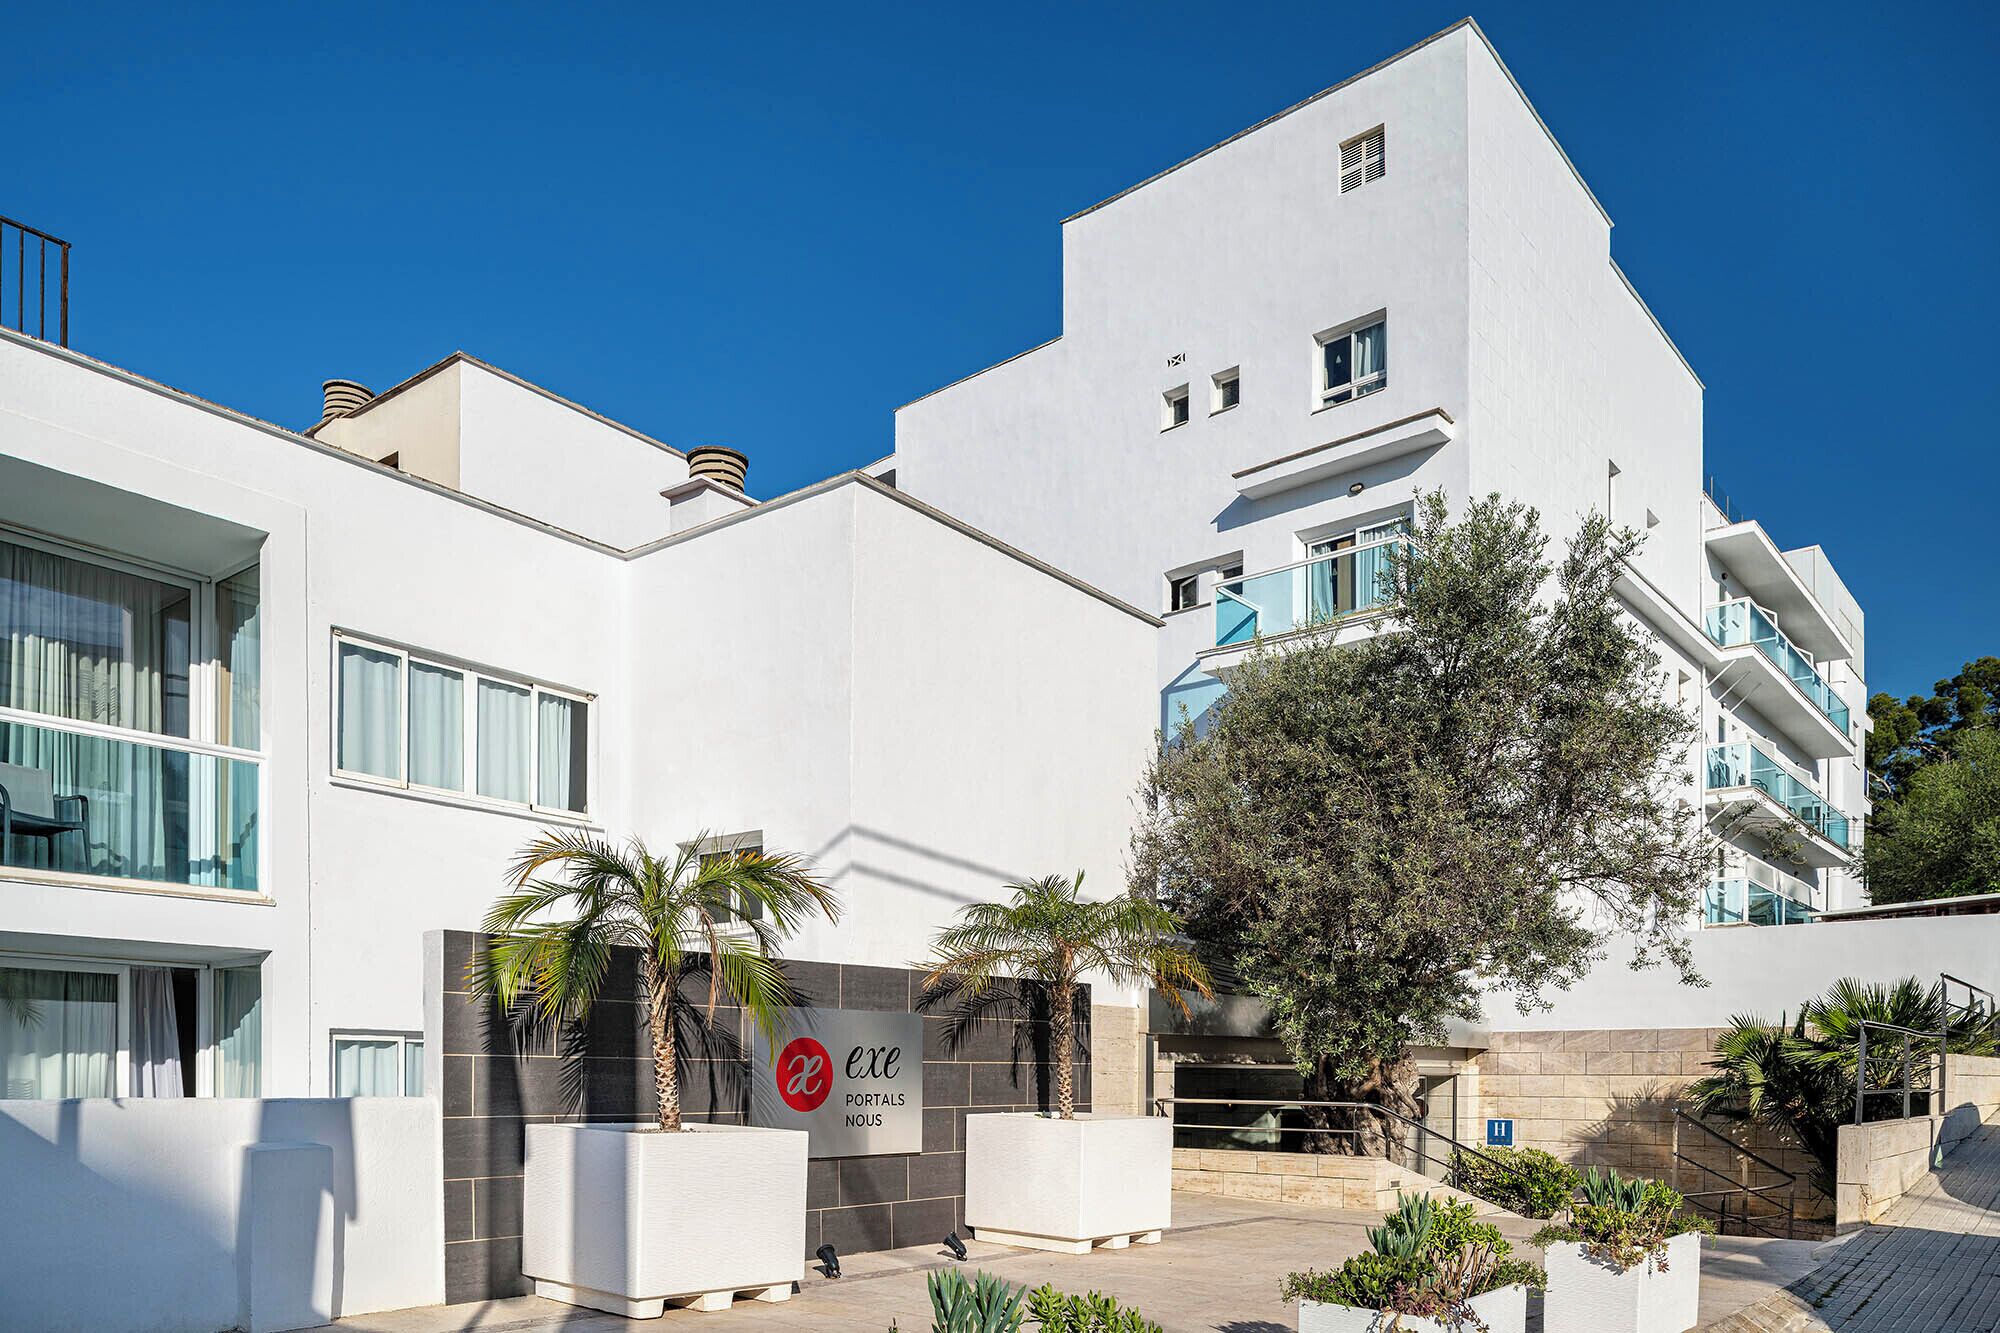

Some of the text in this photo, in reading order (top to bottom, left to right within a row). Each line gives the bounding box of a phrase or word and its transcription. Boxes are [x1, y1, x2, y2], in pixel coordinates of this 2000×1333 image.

[845, 1045, 901, 1080] exe
[846, 1093, 905, 1107] PORTALS
[845, 1113, 883, 1128] NOUS
[1494, 1121, 1506, 1137] H
